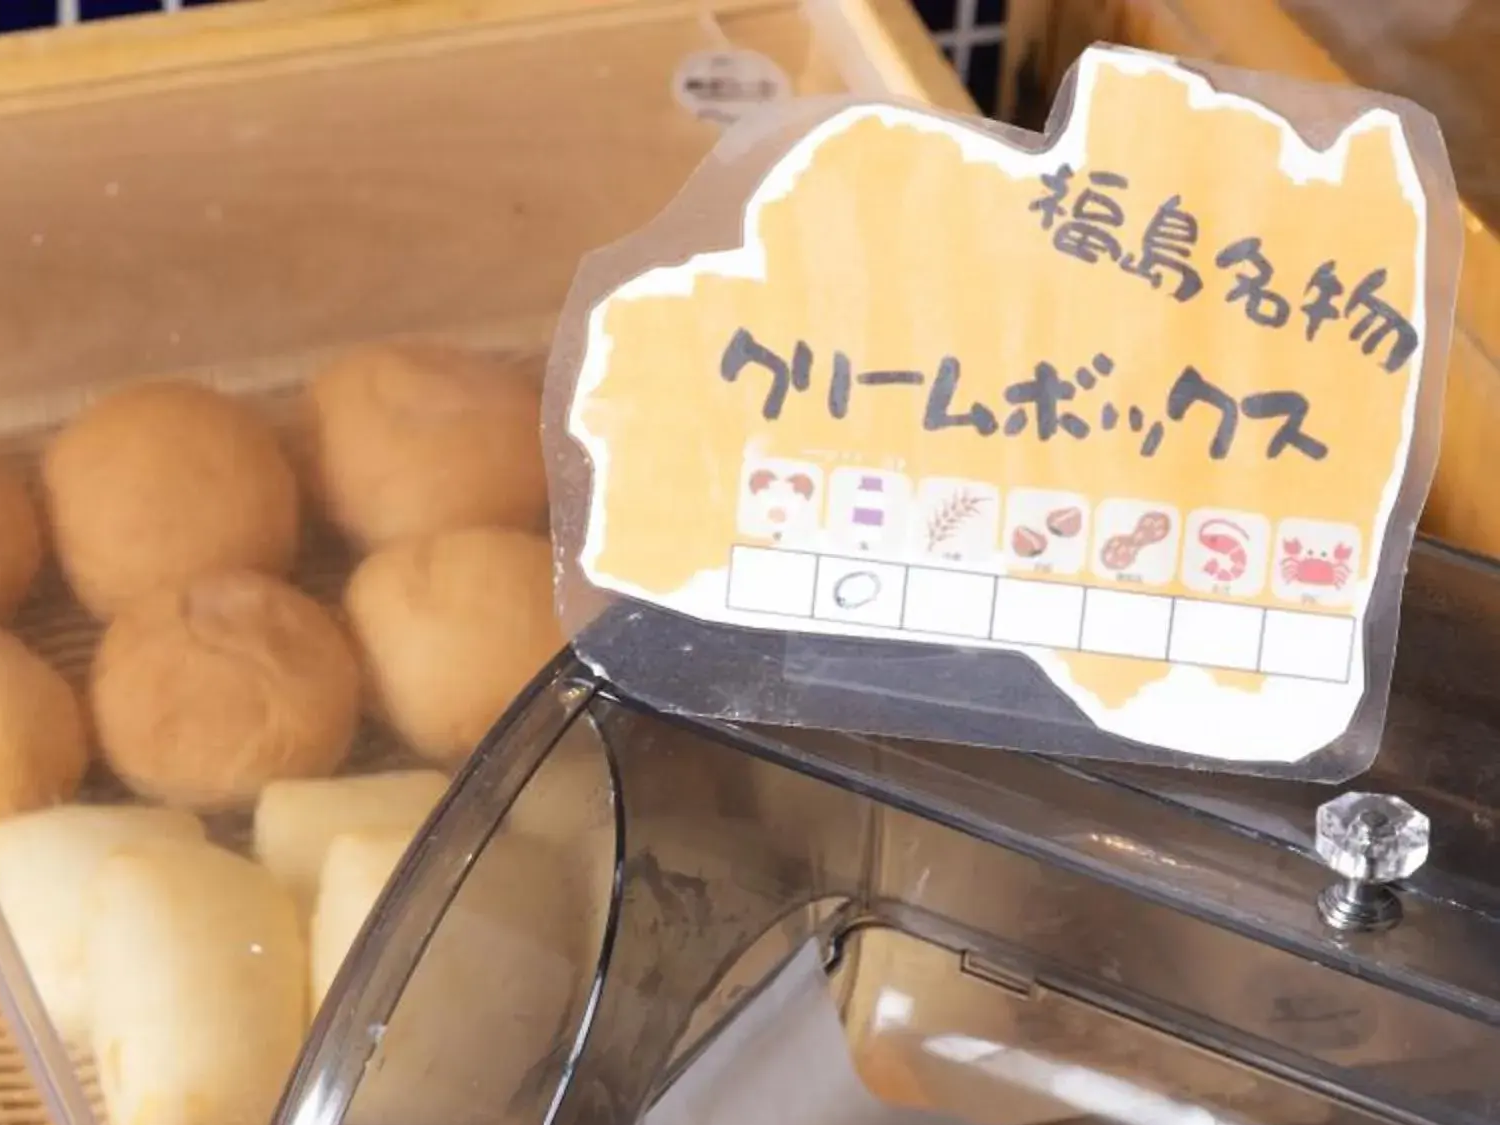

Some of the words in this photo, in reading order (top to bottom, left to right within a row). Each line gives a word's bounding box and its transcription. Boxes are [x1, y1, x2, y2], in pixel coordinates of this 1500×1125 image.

[1027, 162, 1419, 374] 福島名物
[720, 327, 1329, 461] クリームボックス
